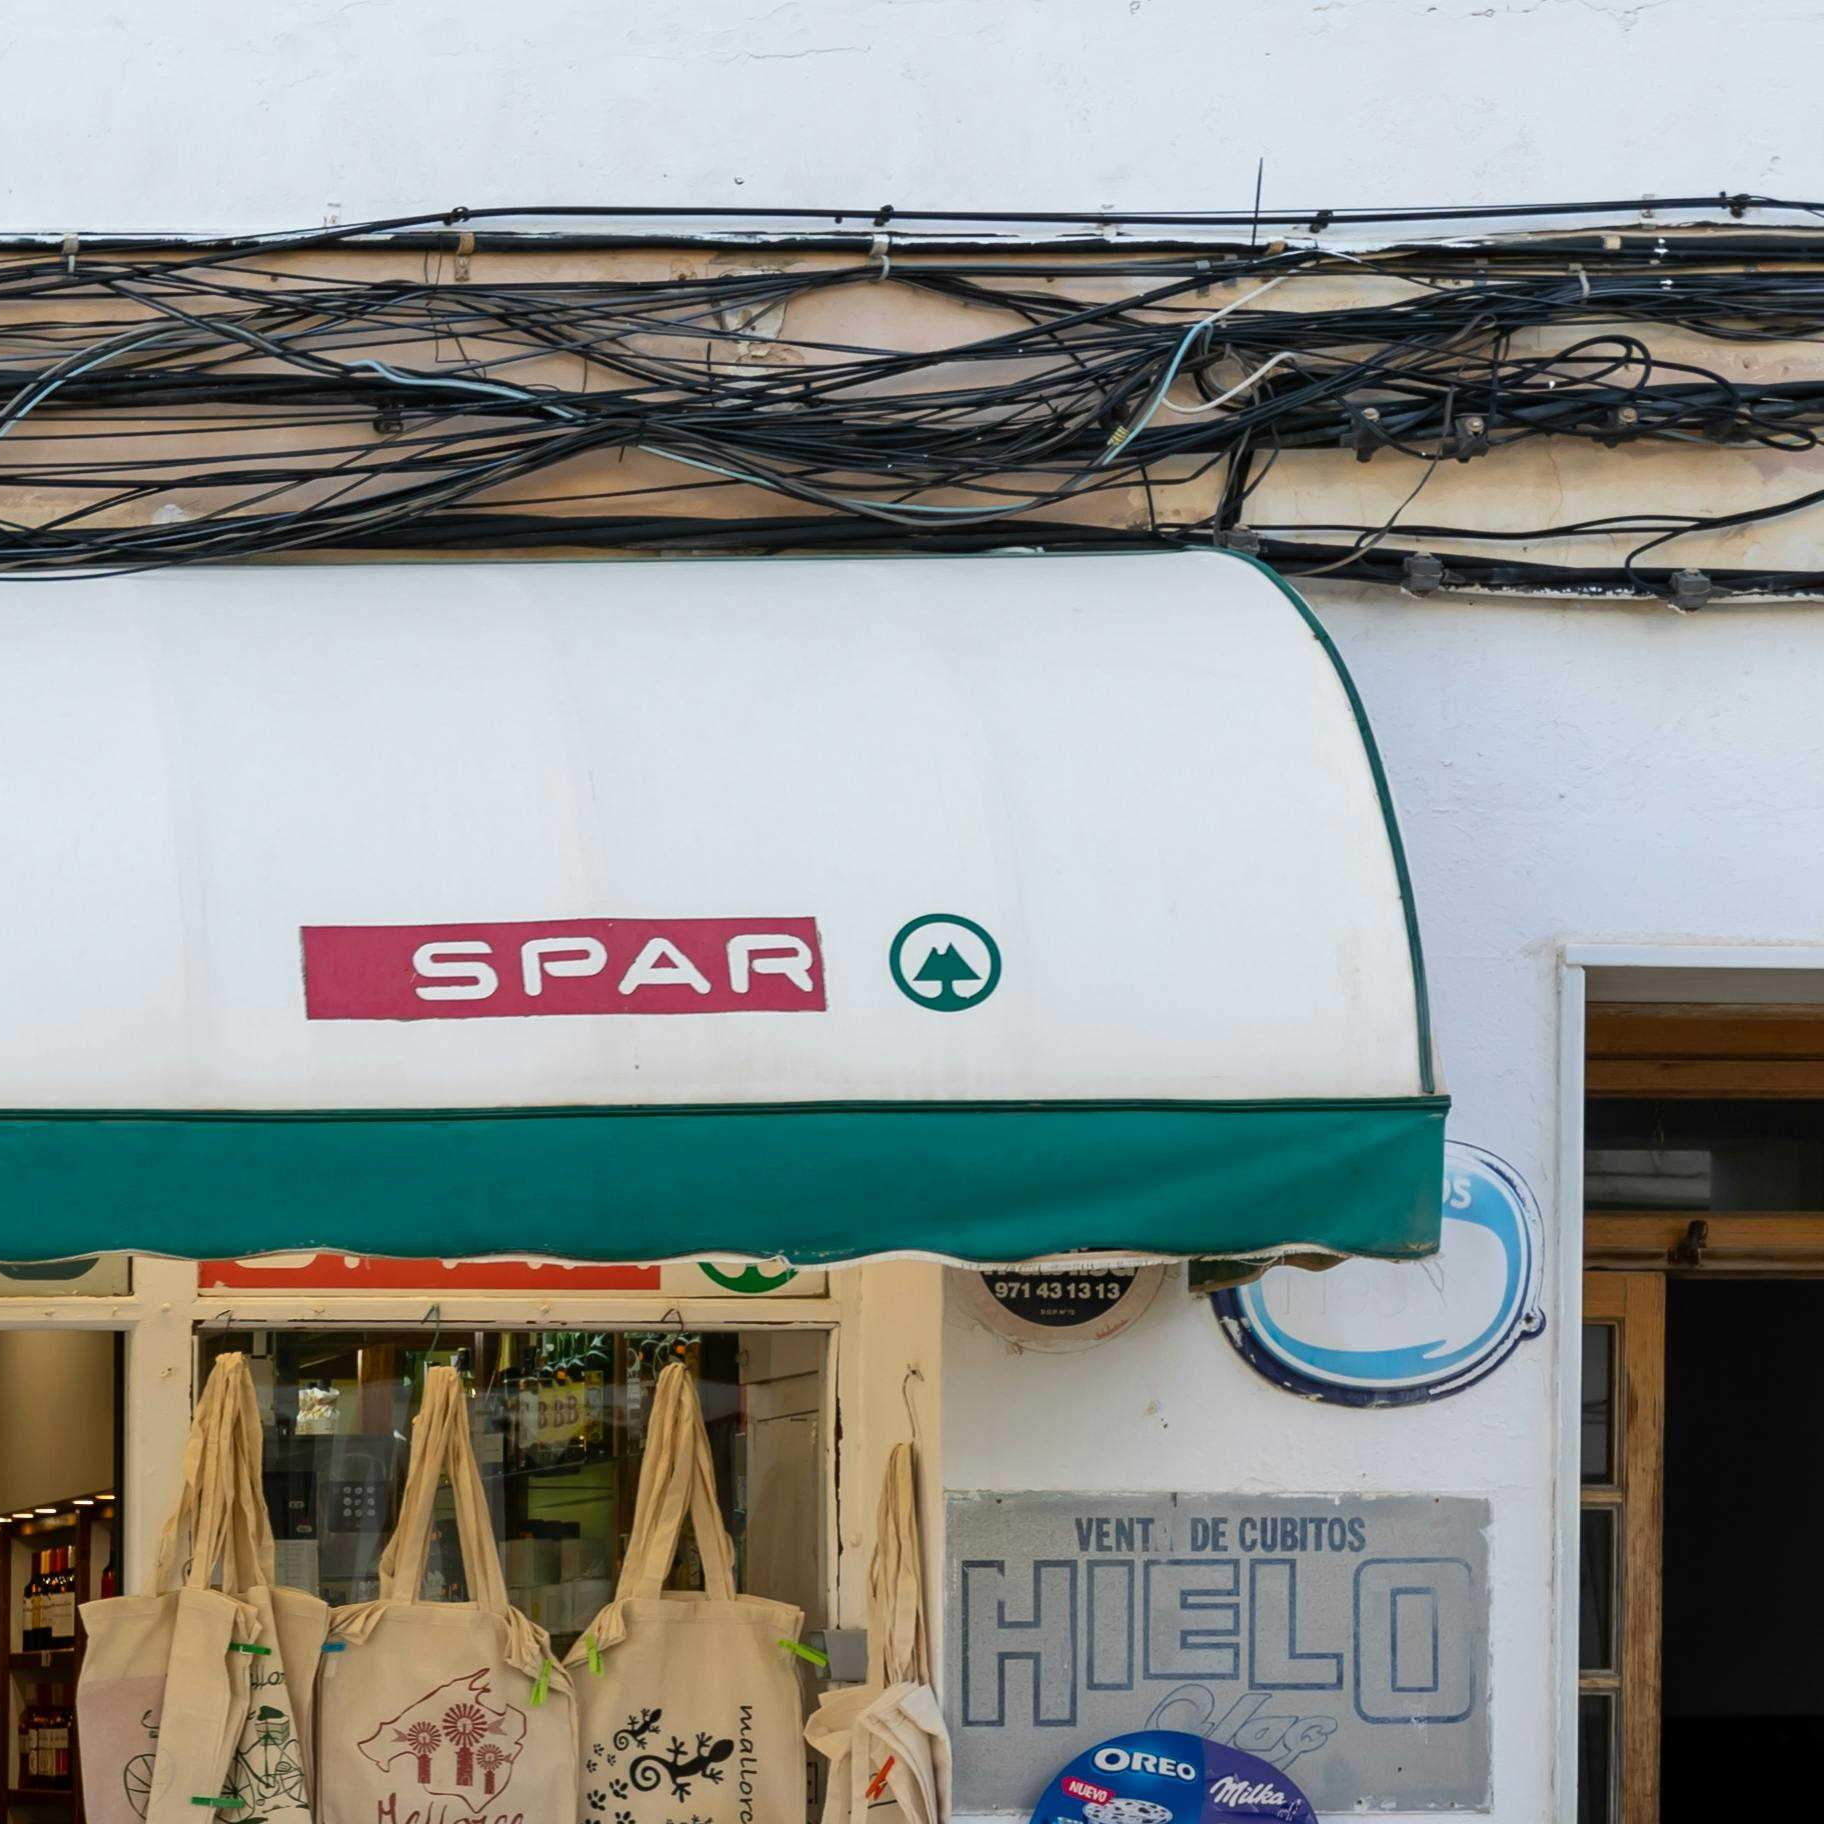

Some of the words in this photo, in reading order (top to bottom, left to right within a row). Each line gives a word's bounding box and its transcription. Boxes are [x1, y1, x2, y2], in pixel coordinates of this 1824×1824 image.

[412, 934, 814, 1000] SPAR
[994, 1282, 1032, 1299] 971
[1036, 1282, 1063, 1299] 43
[1067, 1283, 1092, 1299] 13
[1095, 1283, 1121, 1299] 13
[1075, 1517, 1174, 1553] VENT
[1190, 1517, 1230, 1553] DE
[1238, 1516, 1367, 1553] CUBITOS
[961, 1557, 1477, 1728] HIELO
[1092, 1746, 1197, 1783] OREO
[1068, 1780, 1109, 1804] NUEVO
[1210, 1775, 1287, 1808] Milka
